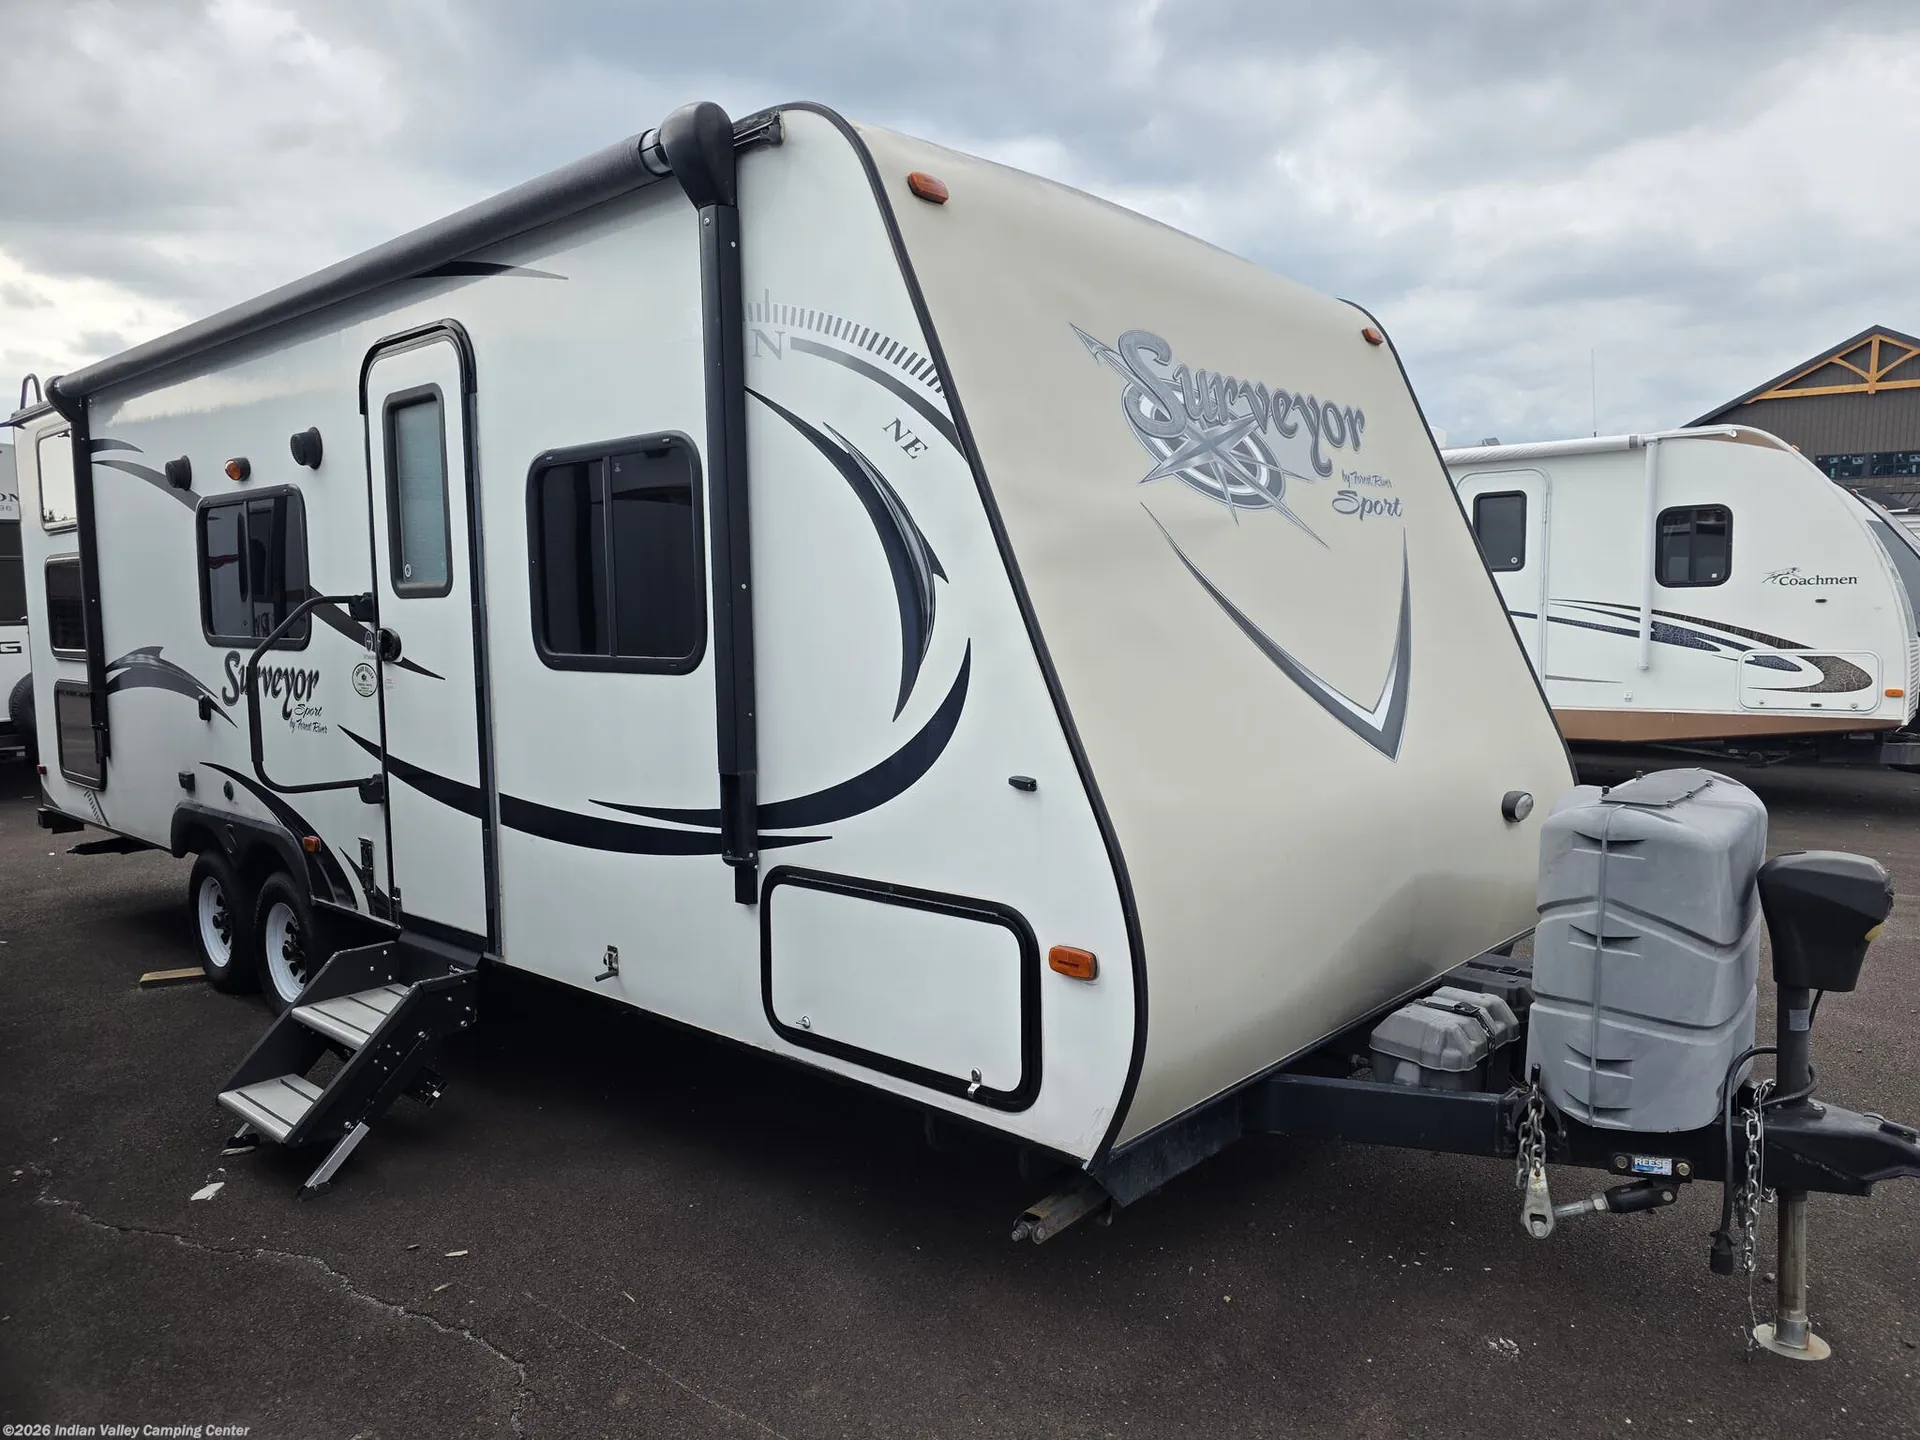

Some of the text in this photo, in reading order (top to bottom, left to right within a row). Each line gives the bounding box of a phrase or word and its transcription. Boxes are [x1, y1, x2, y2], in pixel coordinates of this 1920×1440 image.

[751, 329, 786, 360] N
[1118, 329, 1365, 478] Surveyor
[882, 418, 929, 460] NE
[1332, 490, 1404, 521] Sport
[1779, 575, 1858, 586] Coachmen
